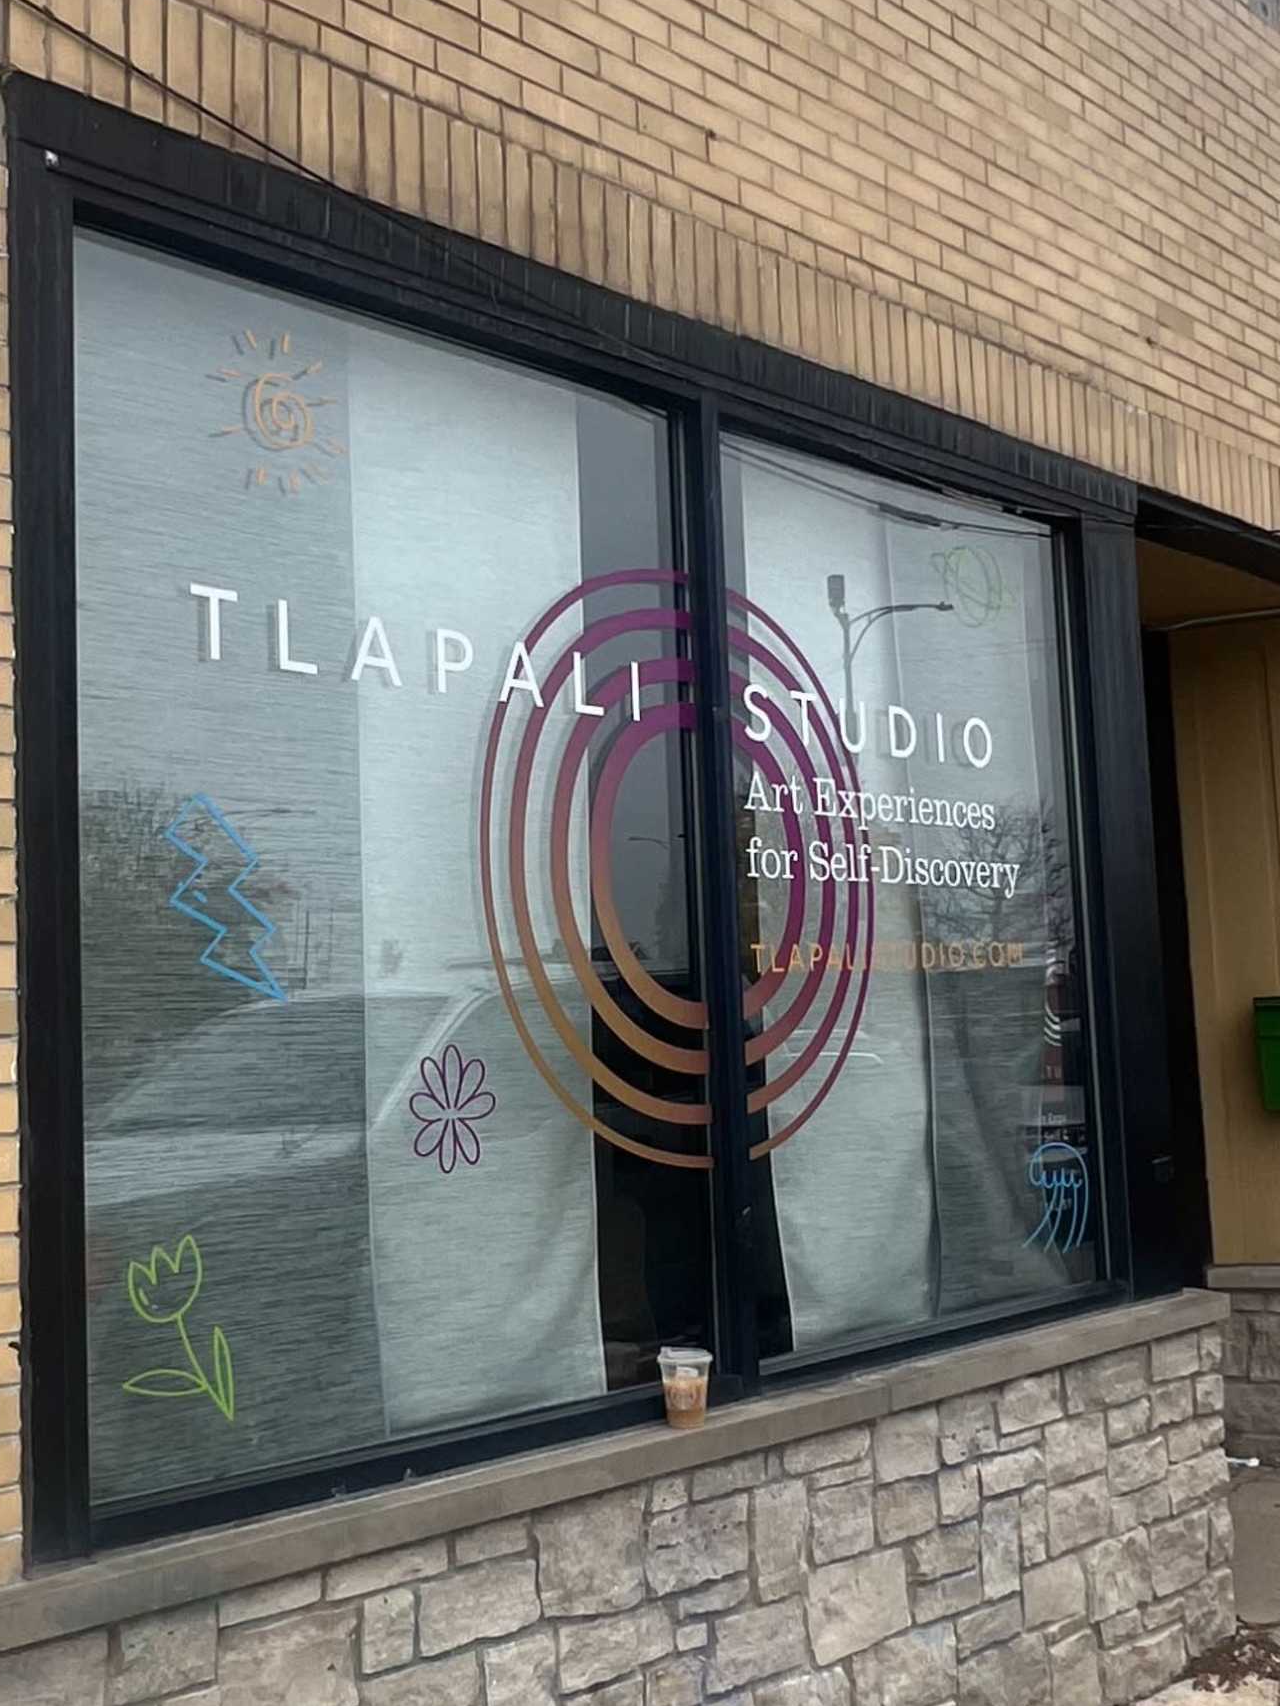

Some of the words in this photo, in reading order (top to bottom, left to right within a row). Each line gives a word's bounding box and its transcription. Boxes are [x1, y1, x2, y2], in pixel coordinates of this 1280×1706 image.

[190, 582, 641, 721] TLAPALI
[743, 684, 993, 769] STUDIO
[743, 770, 804, 814] Art
[813, 777, 995, 831] Experiences
[746, 836, 798, 879] for
[809, 840, 1020, 899] Self-Discovery
[750, 940, 1024, 973] TLAPALIUDIO.COM
